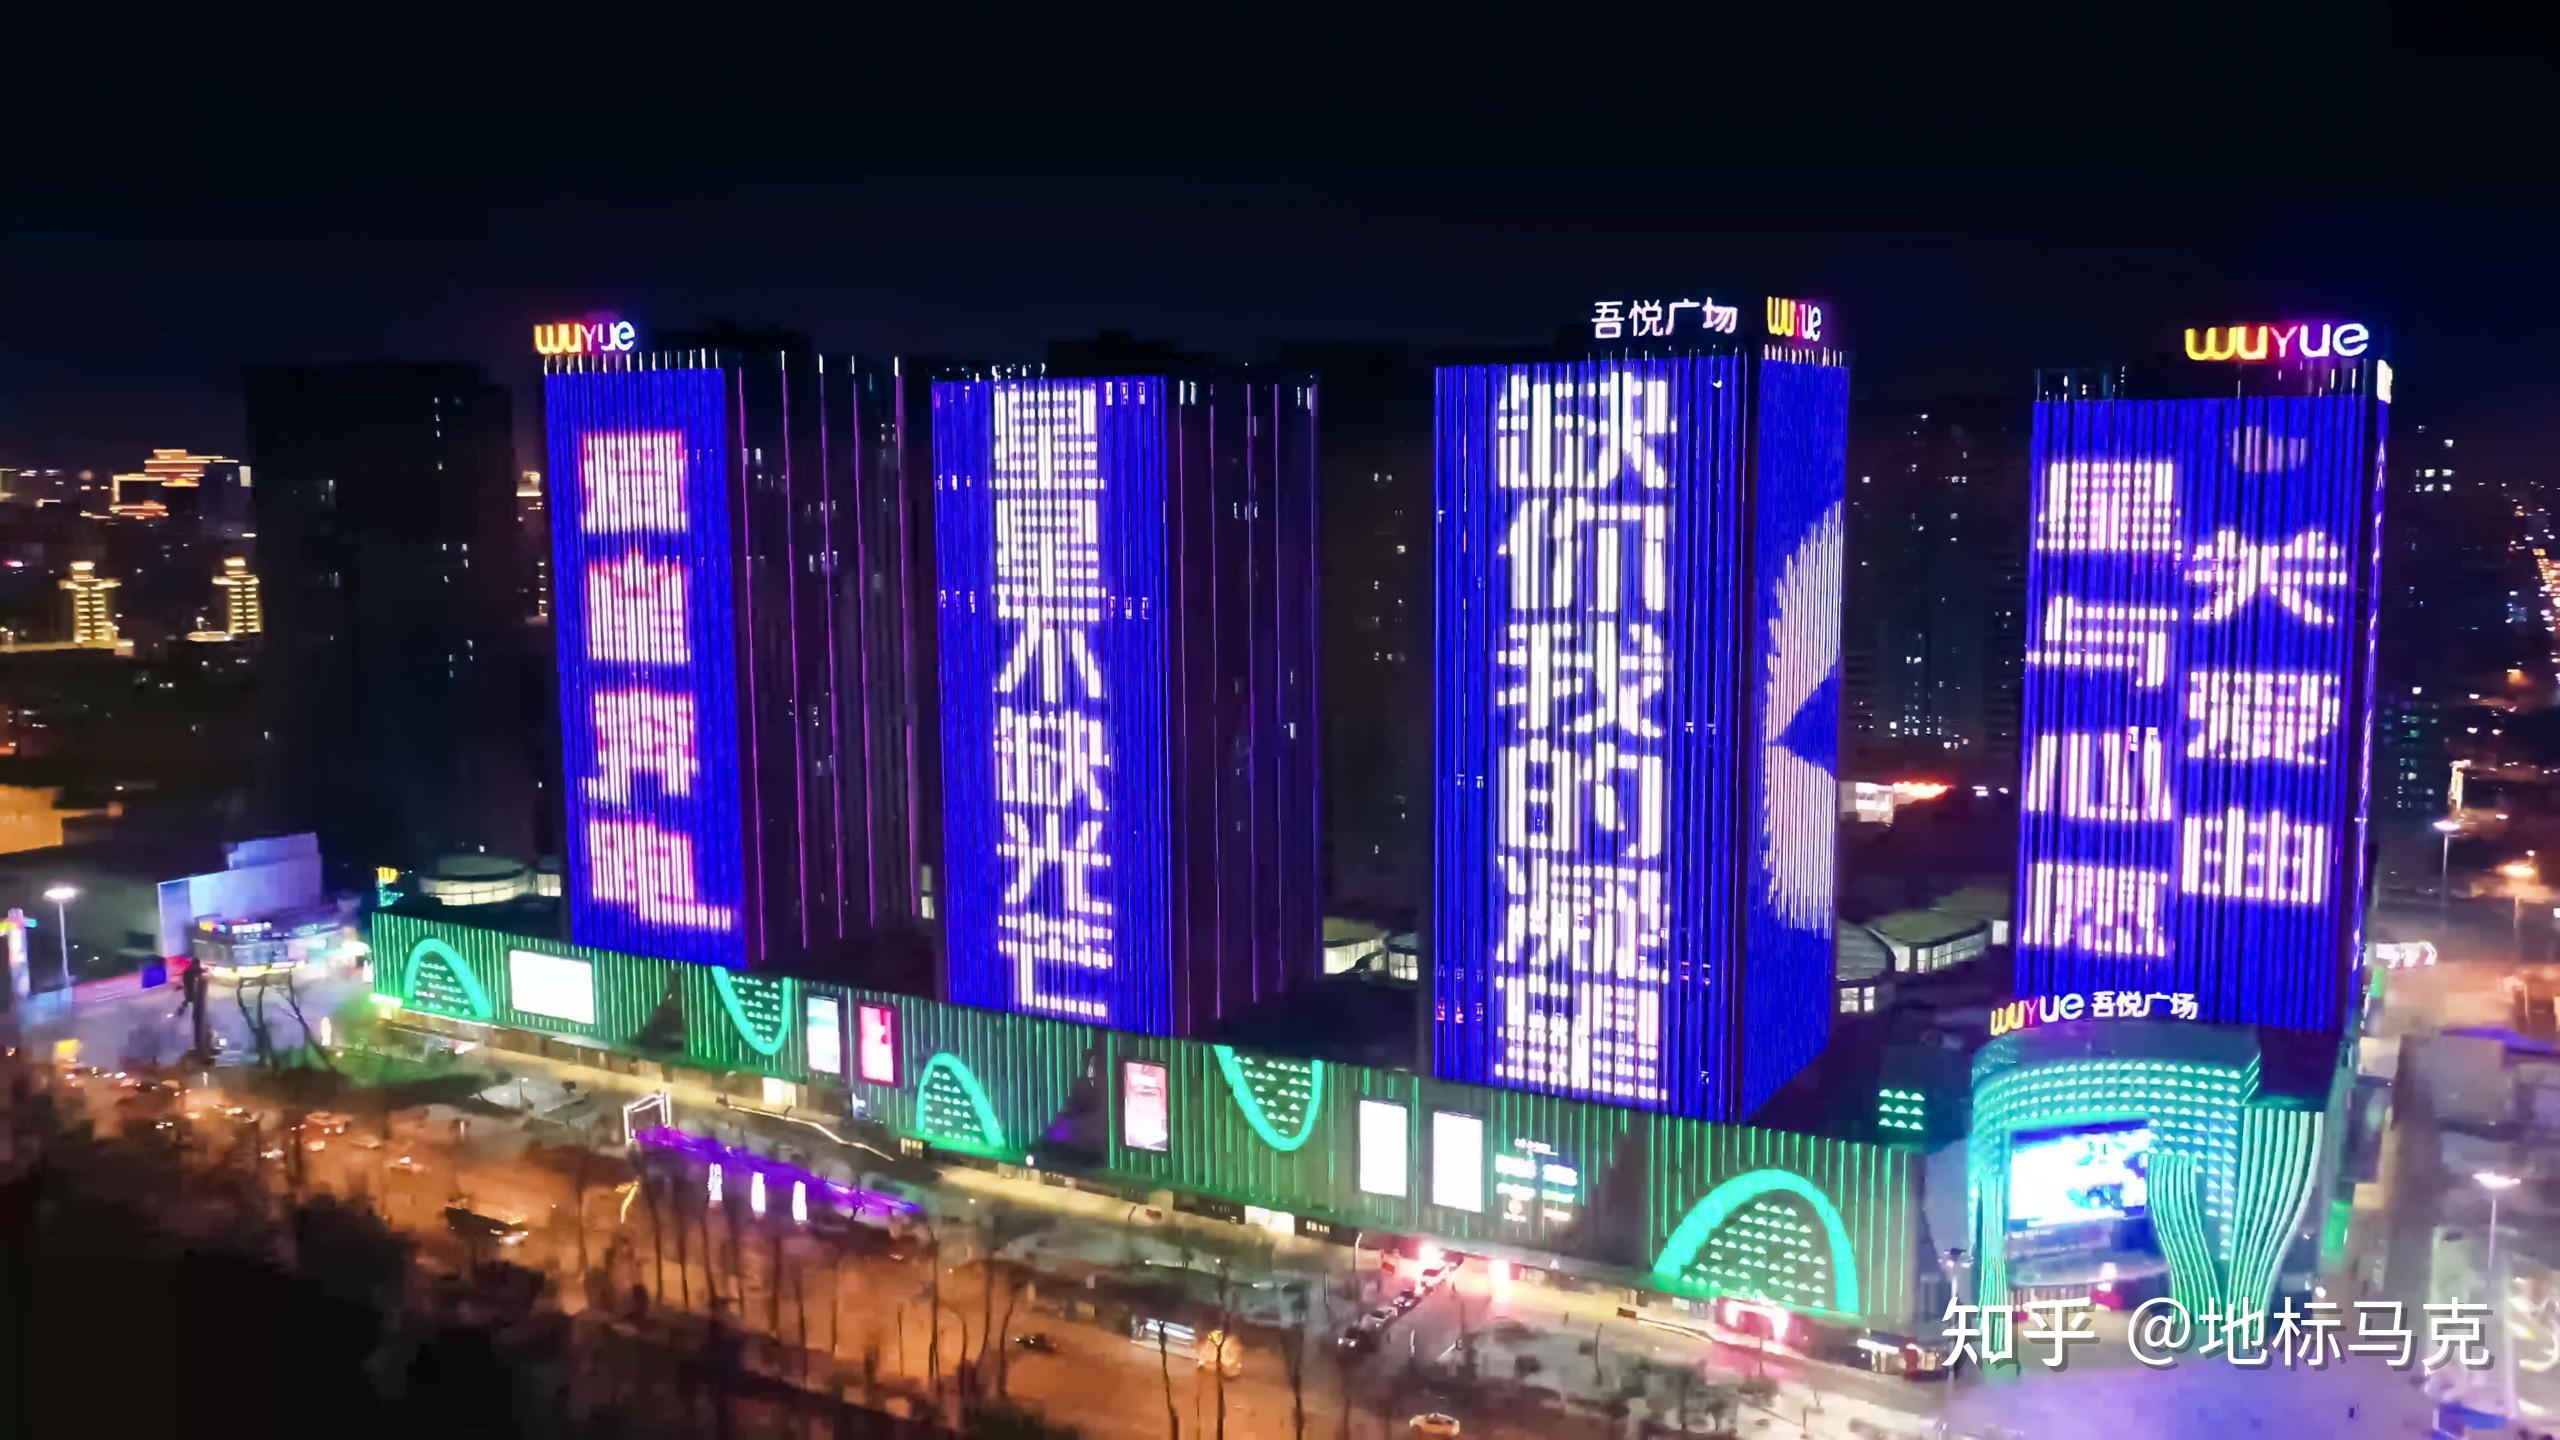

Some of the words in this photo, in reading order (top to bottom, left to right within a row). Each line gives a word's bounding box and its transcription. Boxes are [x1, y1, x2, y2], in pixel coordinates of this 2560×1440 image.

[1591, 297, 1738, 339] 吾悦广场
[2092, 991, 2199, 1020] 吾悦广场
